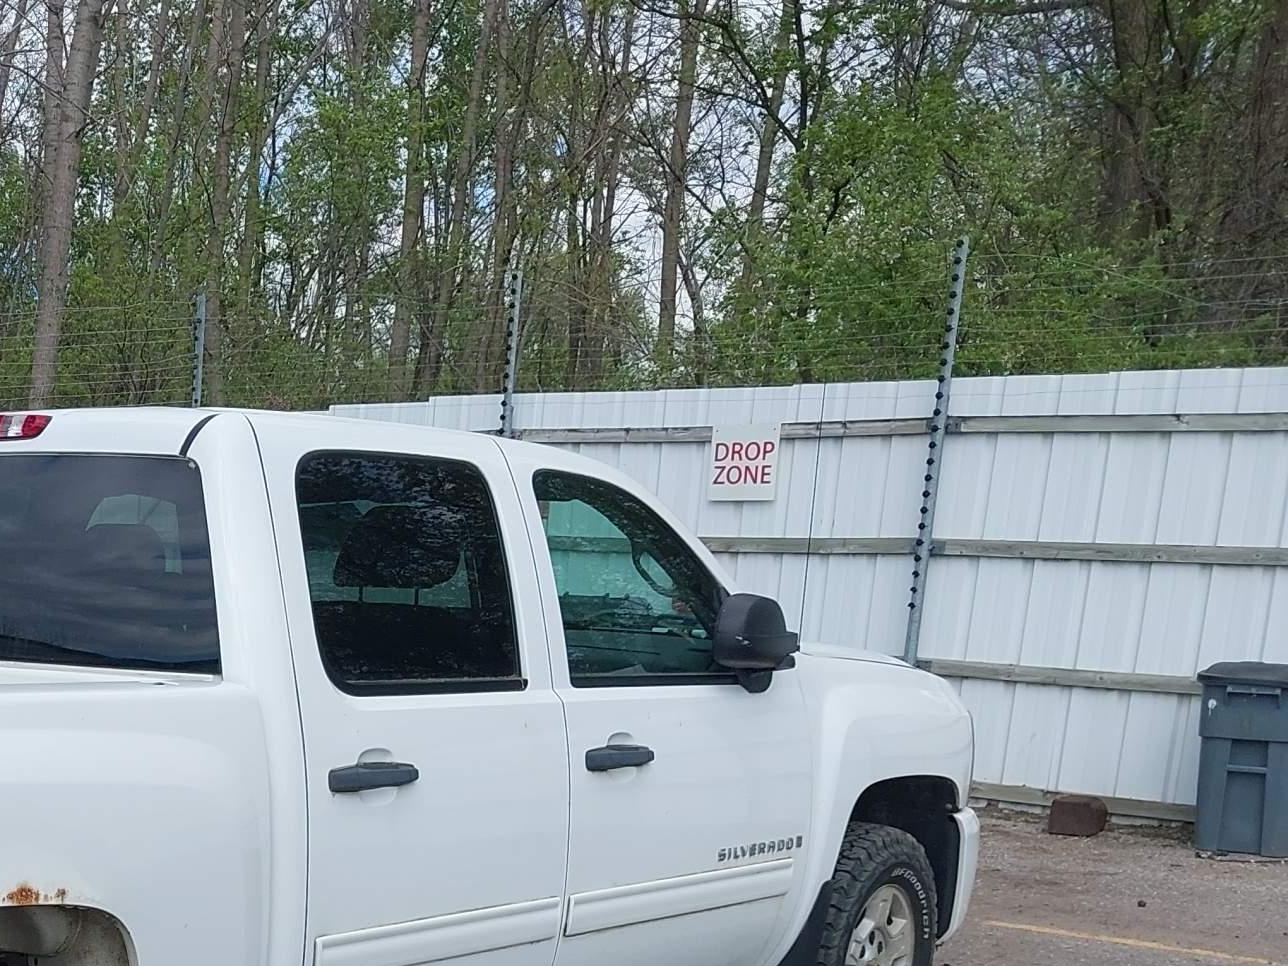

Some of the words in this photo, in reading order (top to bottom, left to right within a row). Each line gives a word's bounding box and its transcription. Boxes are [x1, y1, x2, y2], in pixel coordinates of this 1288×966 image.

[714, 441, 775, 462] DROP
[712, 464, 772, 485] ZONE
[717, 838, 794, 862] SILVERADO
